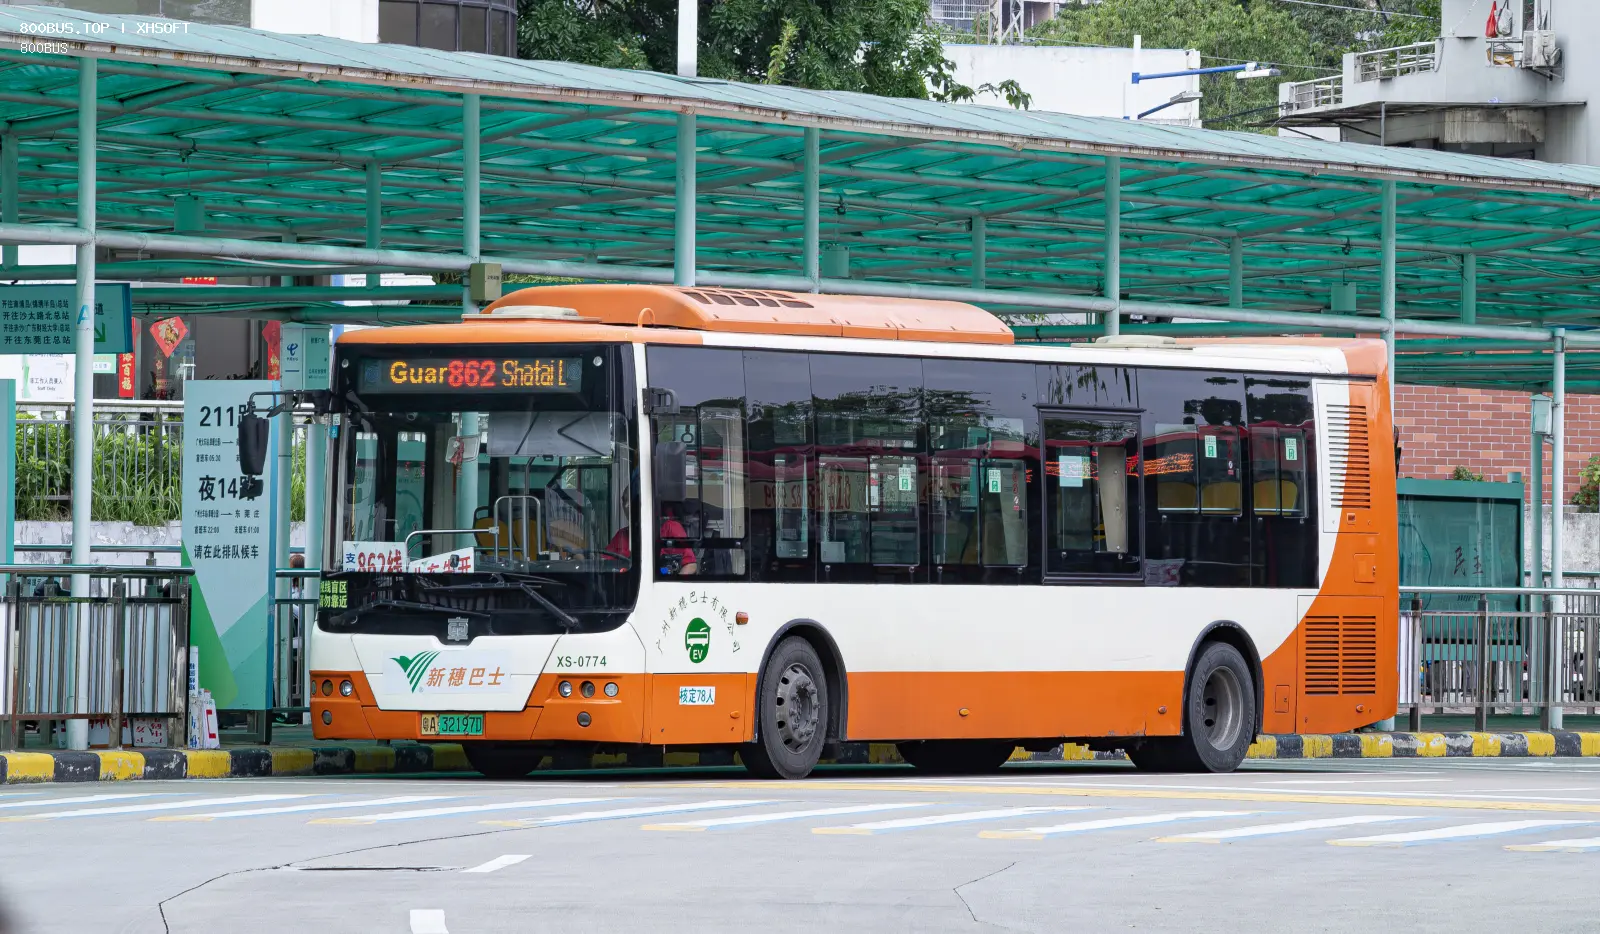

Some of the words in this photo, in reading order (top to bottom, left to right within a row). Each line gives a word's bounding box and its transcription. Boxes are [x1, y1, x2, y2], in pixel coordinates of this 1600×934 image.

[3, 311, 69, 320] 开往沙太路北总站
[4, 336, 71, 344] 开往东莞庄总站
[448, 360, 496, 387] 862
[502, 360, 554, 386] Shatai
[558, 360, 567, 386] L
[235, 509, 260, 518] 东莞庄
[194, 545, 259, 559] 请在此排队候车
[1453, 545, 1484, 577] 民主
[693, 650, 704, 660] EV
[557, 656, 607, 667] XS-0774
[426, 667, 505, 687] 新穗巴士
[680, 688, 714, 703] 核定78人
